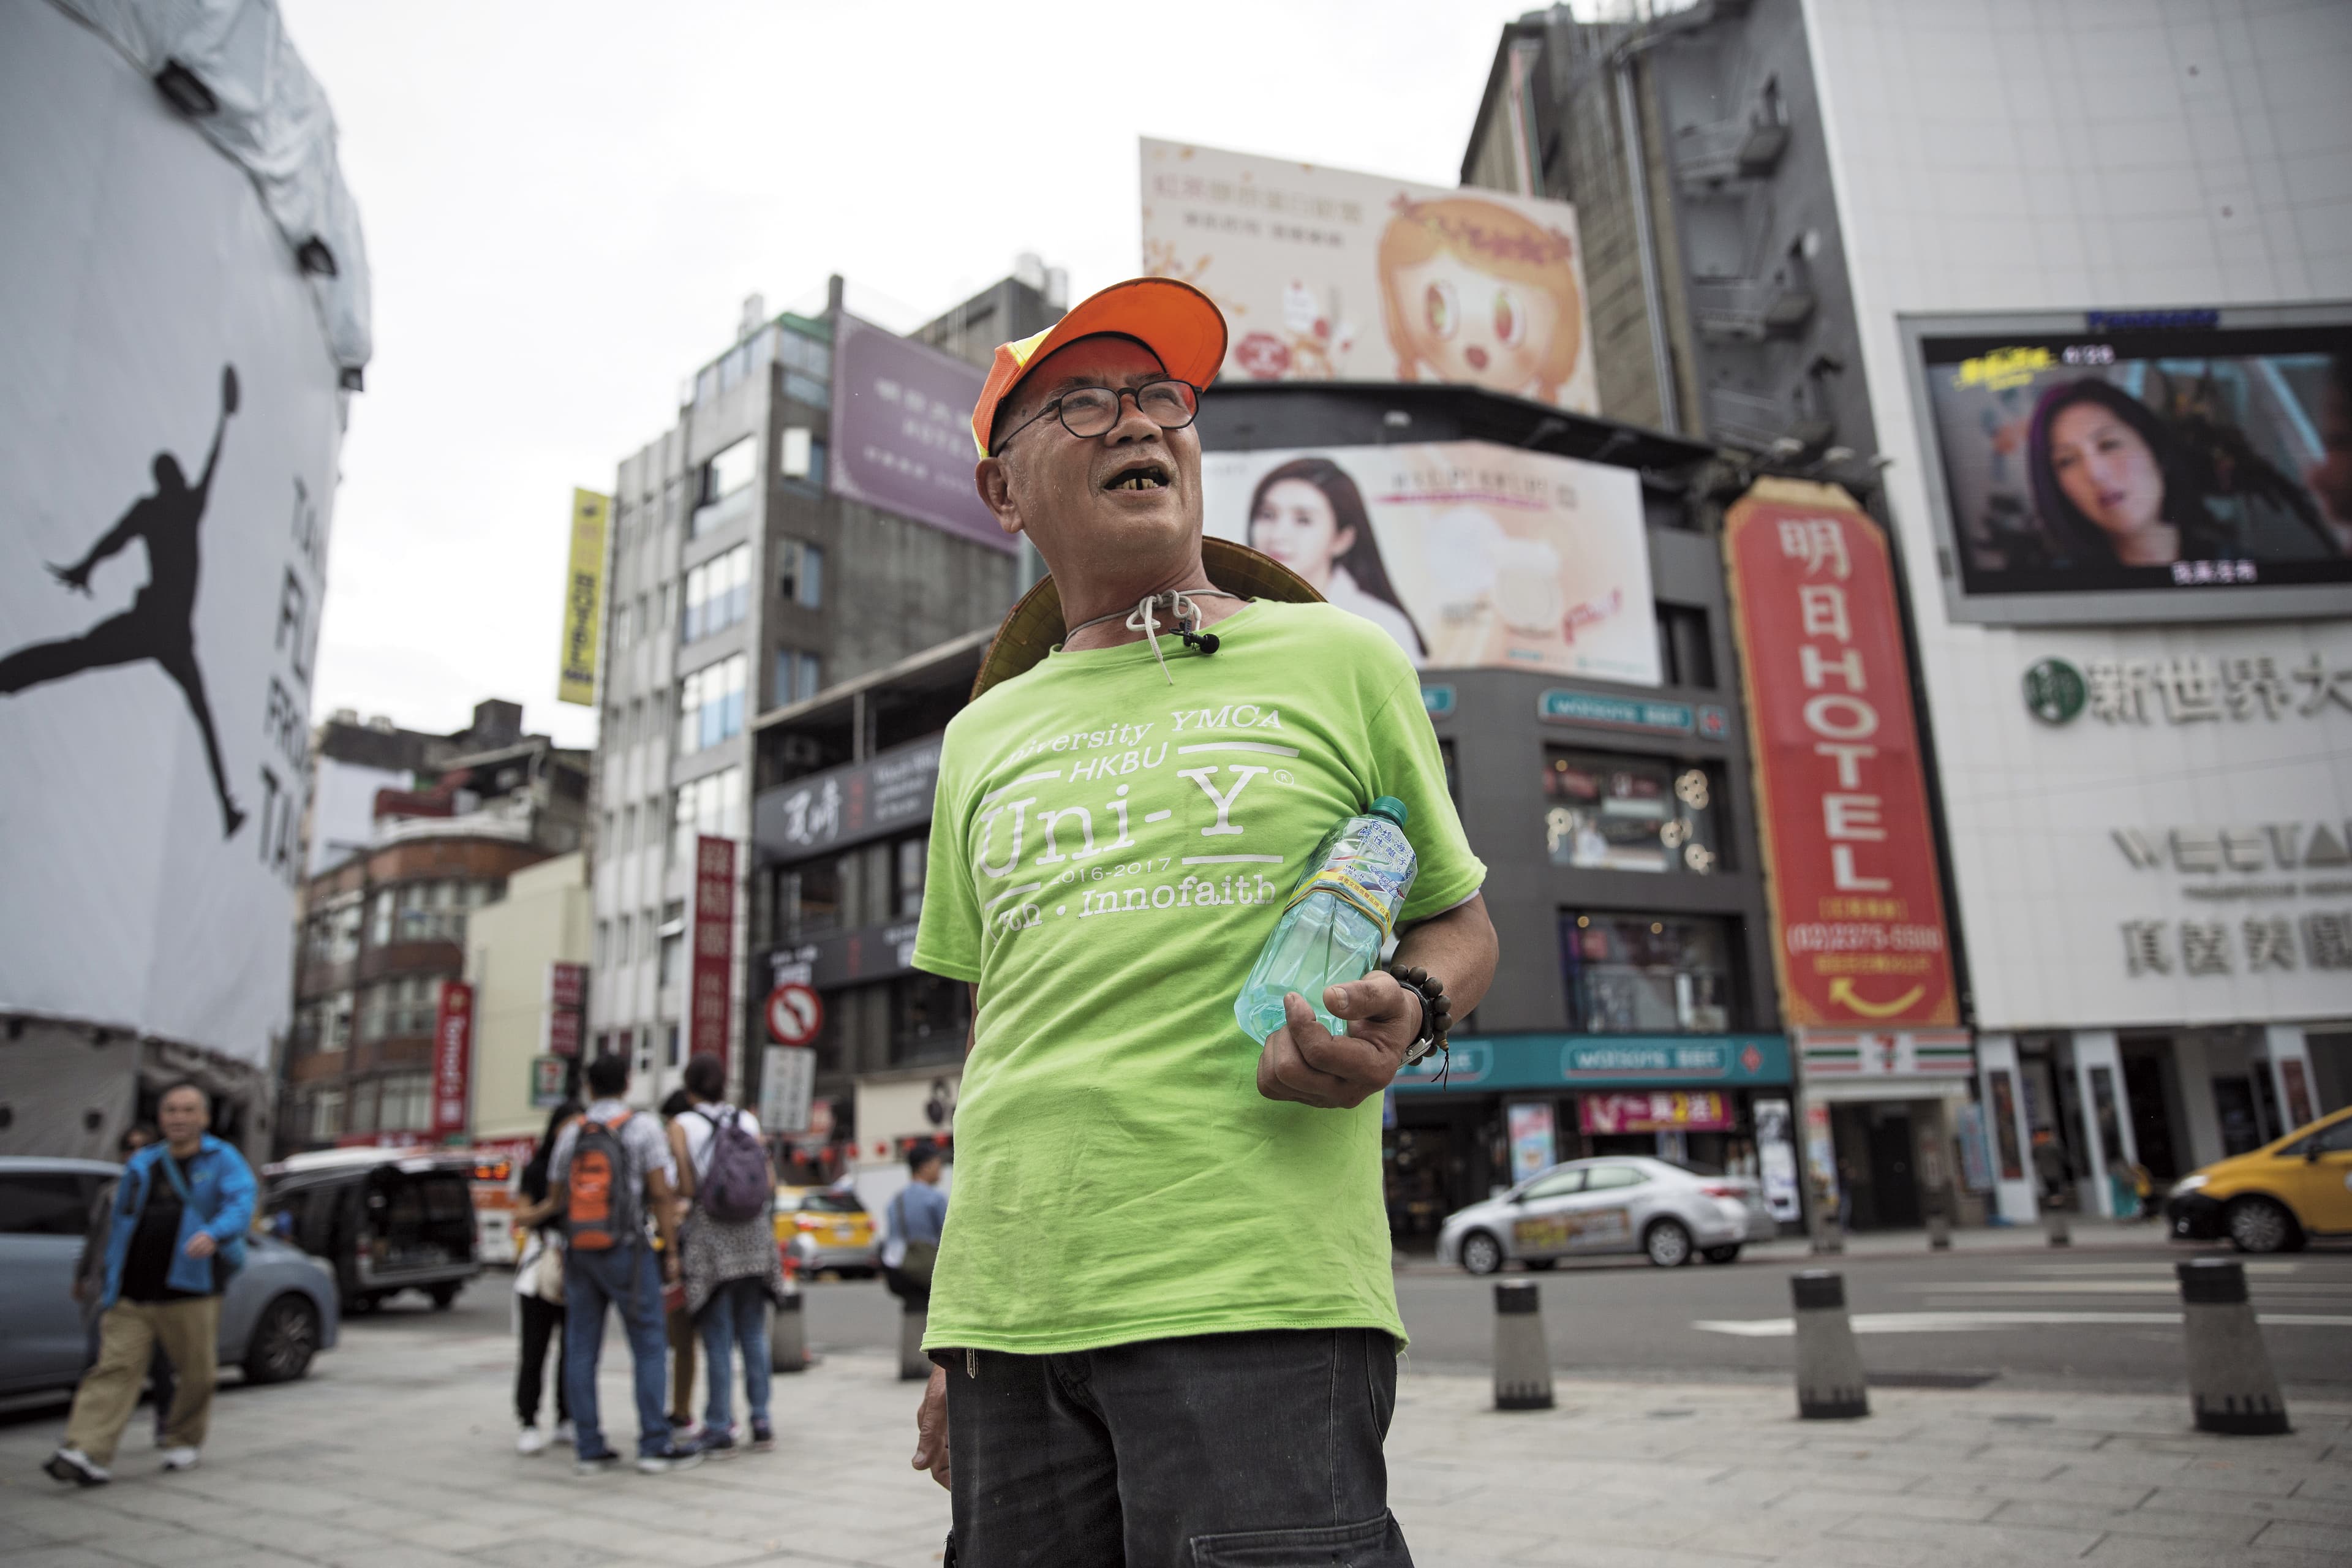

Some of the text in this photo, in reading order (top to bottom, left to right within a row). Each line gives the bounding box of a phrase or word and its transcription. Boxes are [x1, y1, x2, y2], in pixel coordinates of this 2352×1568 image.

[998, 704, 1284, 768] niversity YMCA
[1069, 742, 1168, 783] HKBU
[1050, 856, 1171, 886] 016-2017
[1078, 875, 1277, 919] Innofaith
